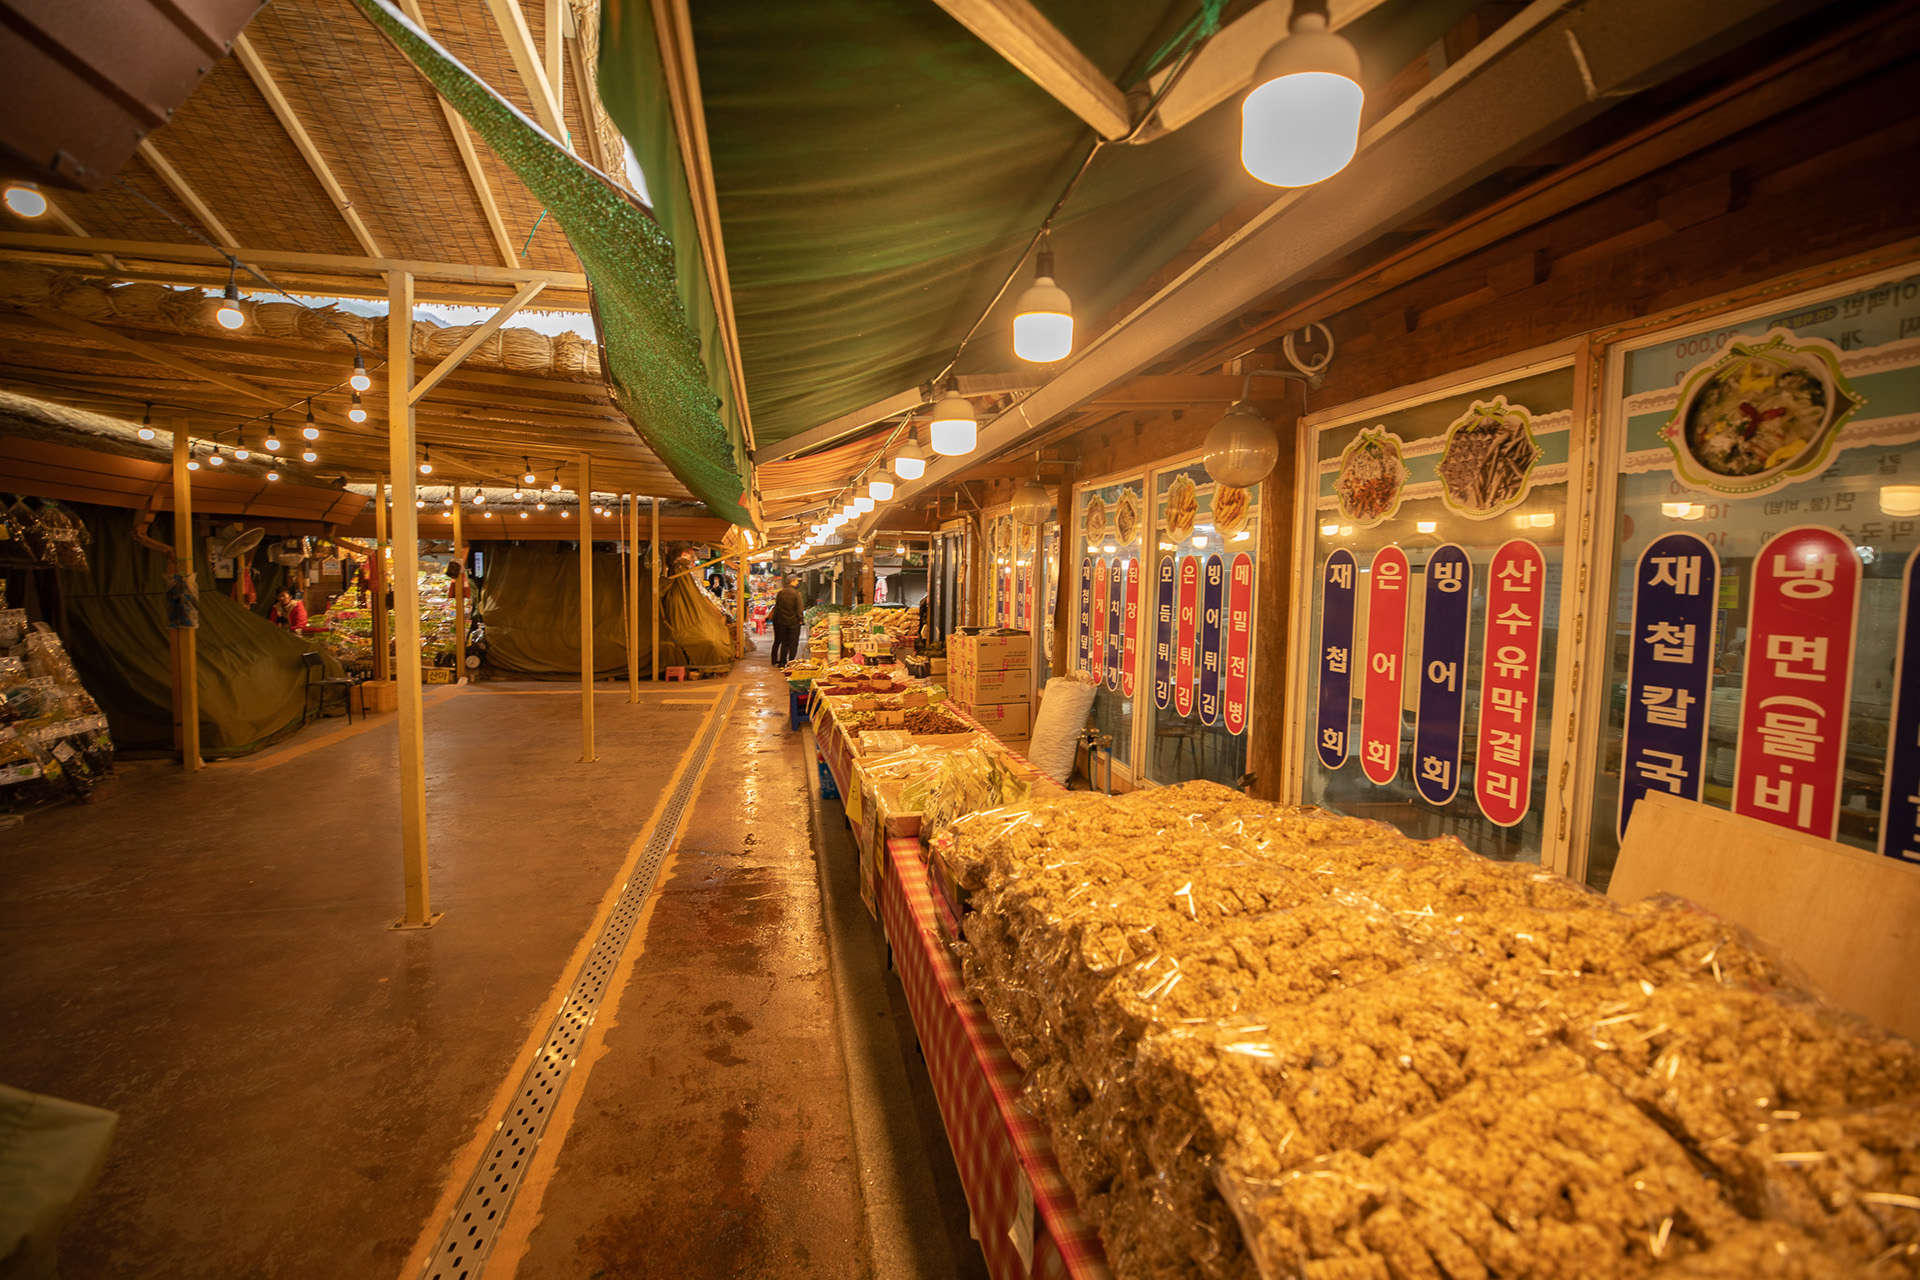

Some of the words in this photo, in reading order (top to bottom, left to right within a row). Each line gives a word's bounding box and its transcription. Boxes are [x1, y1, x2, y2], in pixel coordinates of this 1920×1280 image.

[1107, 567, 1121, 684] 김치찌개
[1124, 567, 1138, 690] 된장찌개
[1156, 566, 1173, 700] 모듬튀김
[1178, 565, 1196, 707] 은어튀김
[1202, 564, 1221, 716] 빙어튀김
[1228, 564, 1249, 724] 메밀전병
[1321, 563, 1353, 757] 재첩회
[1367, 562, 1403, 771] 은어회
[1421, 562, 1463, 791] 빙어회
[1486, 559, 1537, 809] 산수유막걸리
[1635, 555, 1702, 794] 재첩칼국
